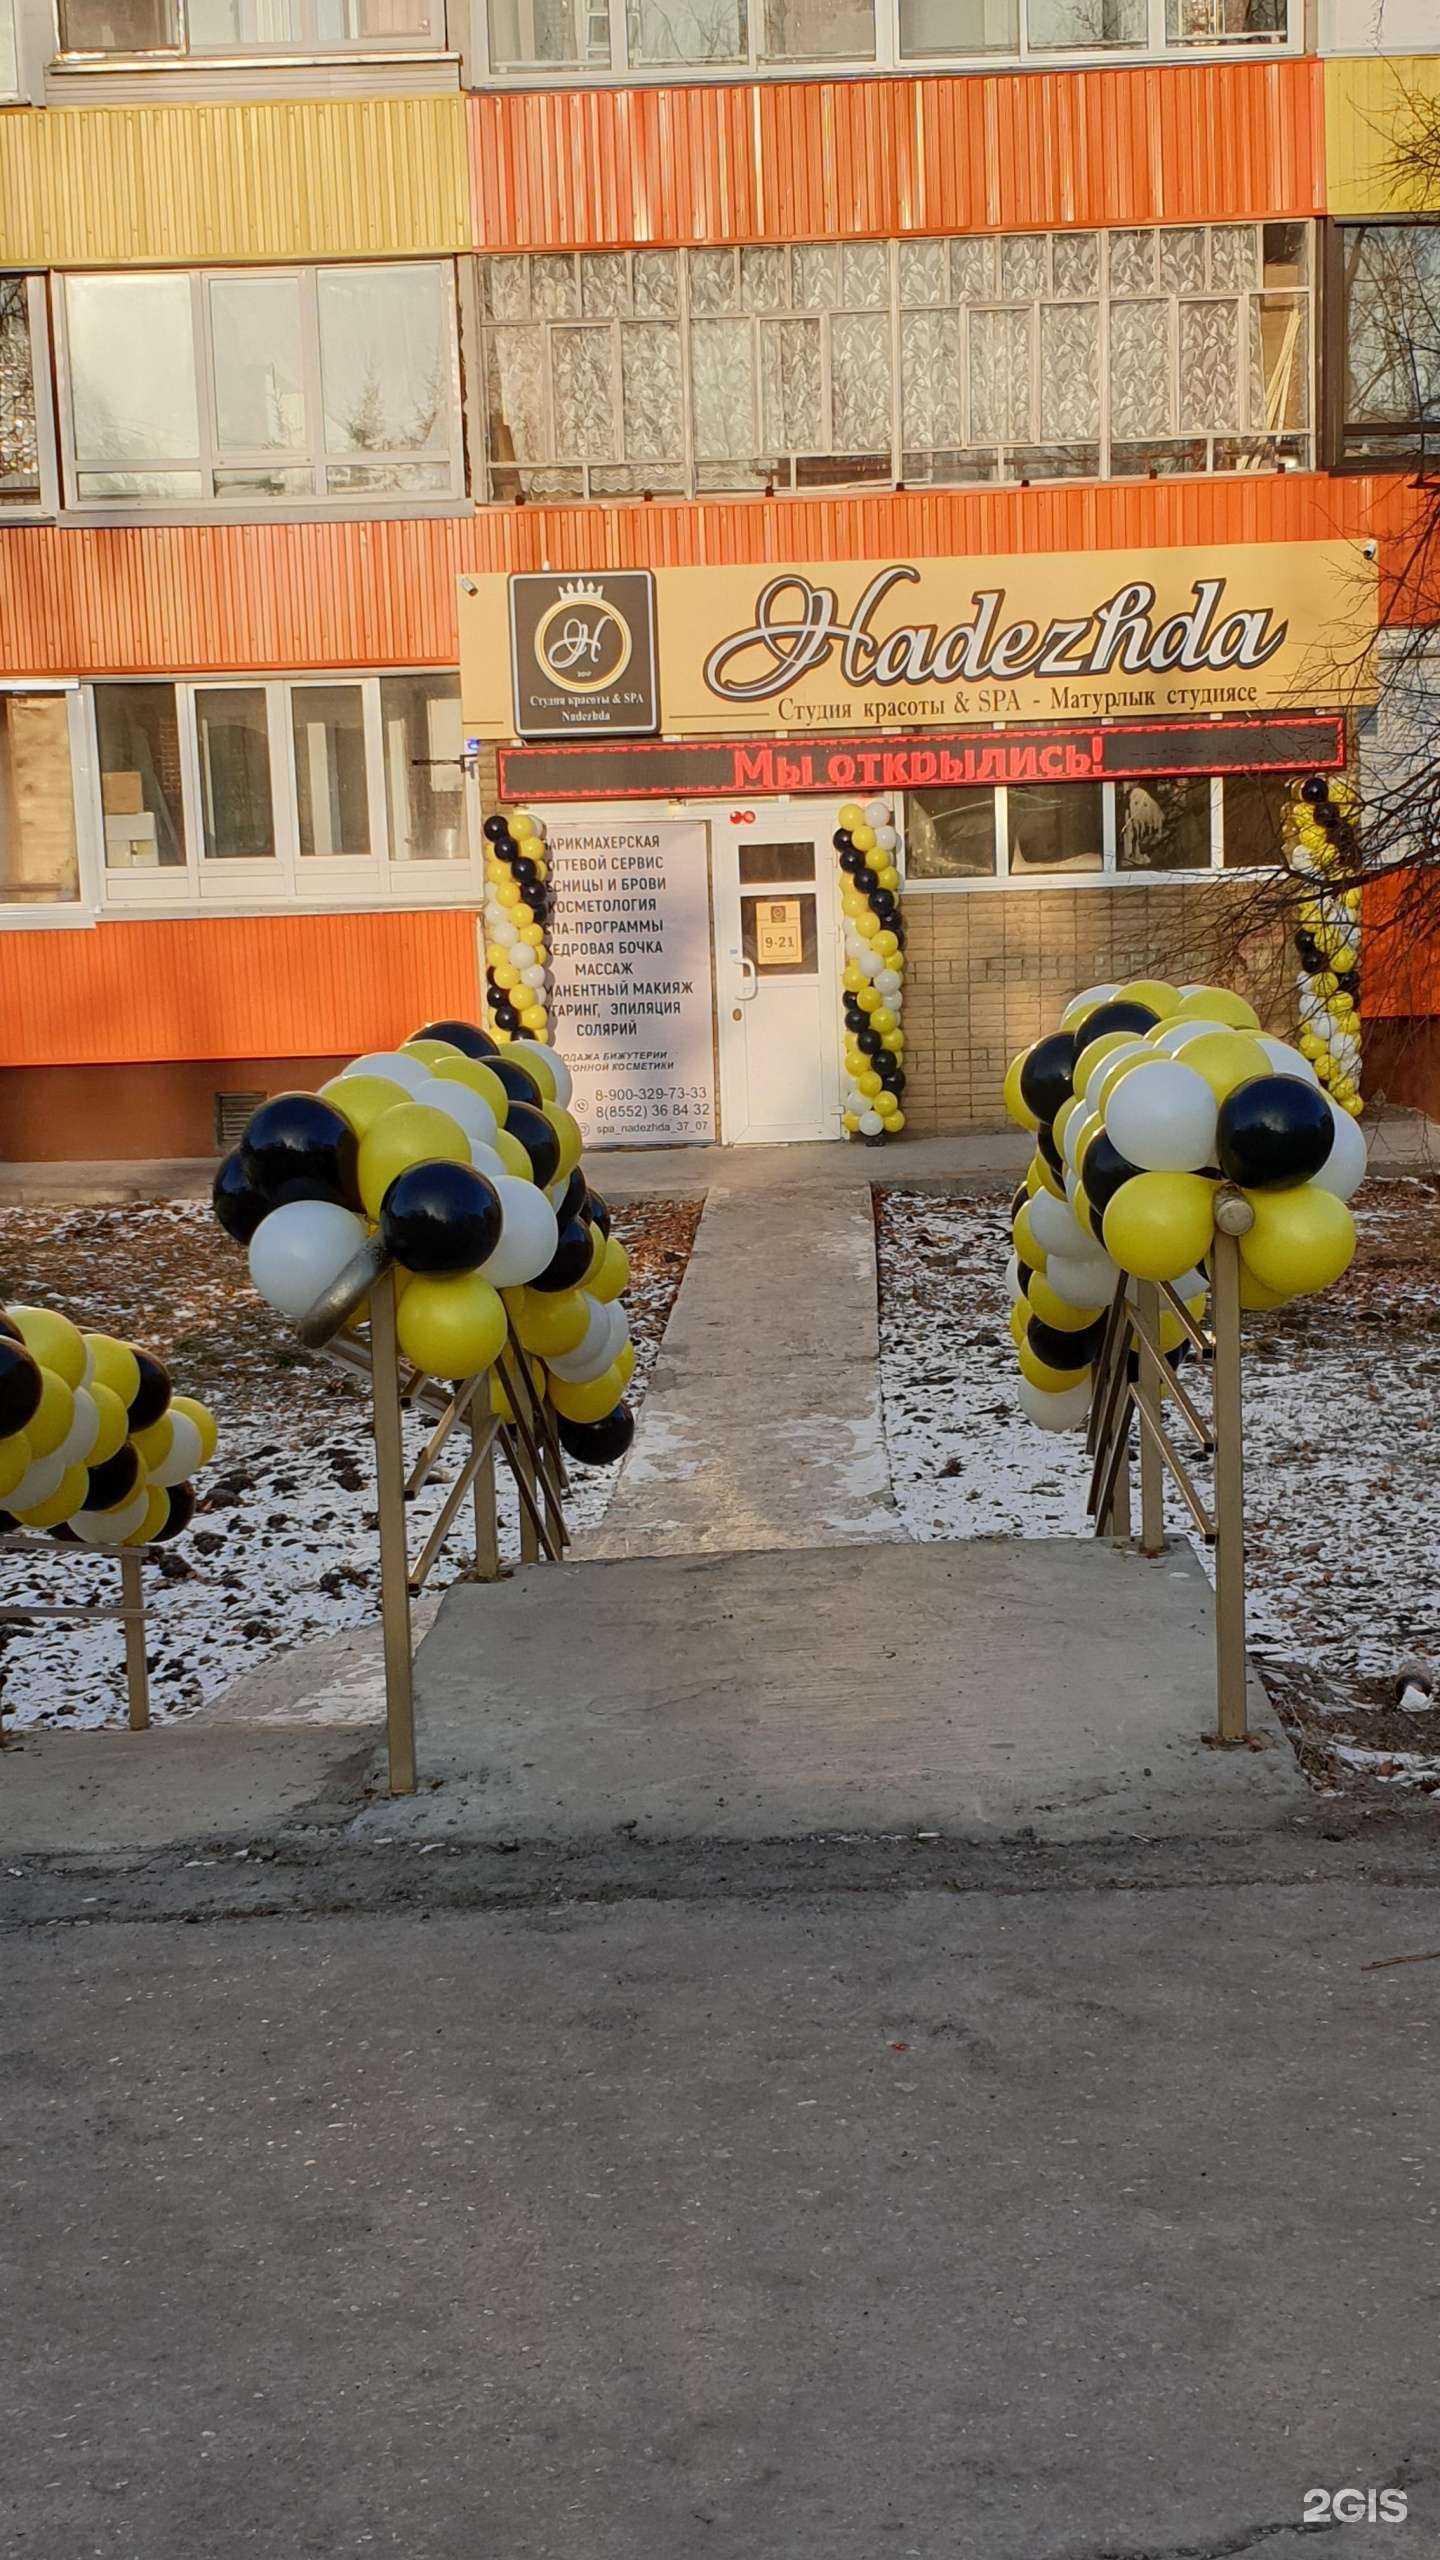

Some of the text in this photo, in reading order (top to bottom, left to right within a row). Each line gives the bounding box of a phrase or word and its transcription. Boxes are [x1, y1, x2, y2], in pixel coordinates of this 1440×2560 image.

[612, 693, 621, 704] &
[624, 692, 644, 704] SPA
[778, 698, 852, 726] Студия
[863, 698, 945, 725] красоты
[954, 692, 971, 714] &
[978, 691, 1021, 713] SPA
[1050, 686, 1157, 715] Матурлык
[1166, 684, 1258, 706] студиясе
[733, 749, 813, 788] Мы
[546, 855, 664, 872] ОГТЕВОЙ СЕРВИС
[546, 877, 667, 893] ЕСНИЦЫ И БРОВИ
[548, 898, 657, 914] КОСМЕТОЛОГИЯ
[545, 919, 664, 936] СПА-ПРОГРАММЫ
[619, 941, 664, 954] БОЧКА
[575, 962, 634, 977] МАССАЖ
[546, 980, 695, 998] МАНЕНТНЫЙ МАКИЯЖ
[546, 1001, 681, 1018] УГАРИНГ, ЭПИЛЯЦИЯ
[576, 1020, 638, 1037] СОЛЯРИЙ
[561, 1051, 668, 1062] ОДАЖА БИЖУТЕРИИ
[612, 1062, 675, 1072] КОСМЕТИКИ
[595, 1086, 707, 1101] 8-900-329-73-33
[596, 1103, 710, 1120] 8(8552) 36 84 32
